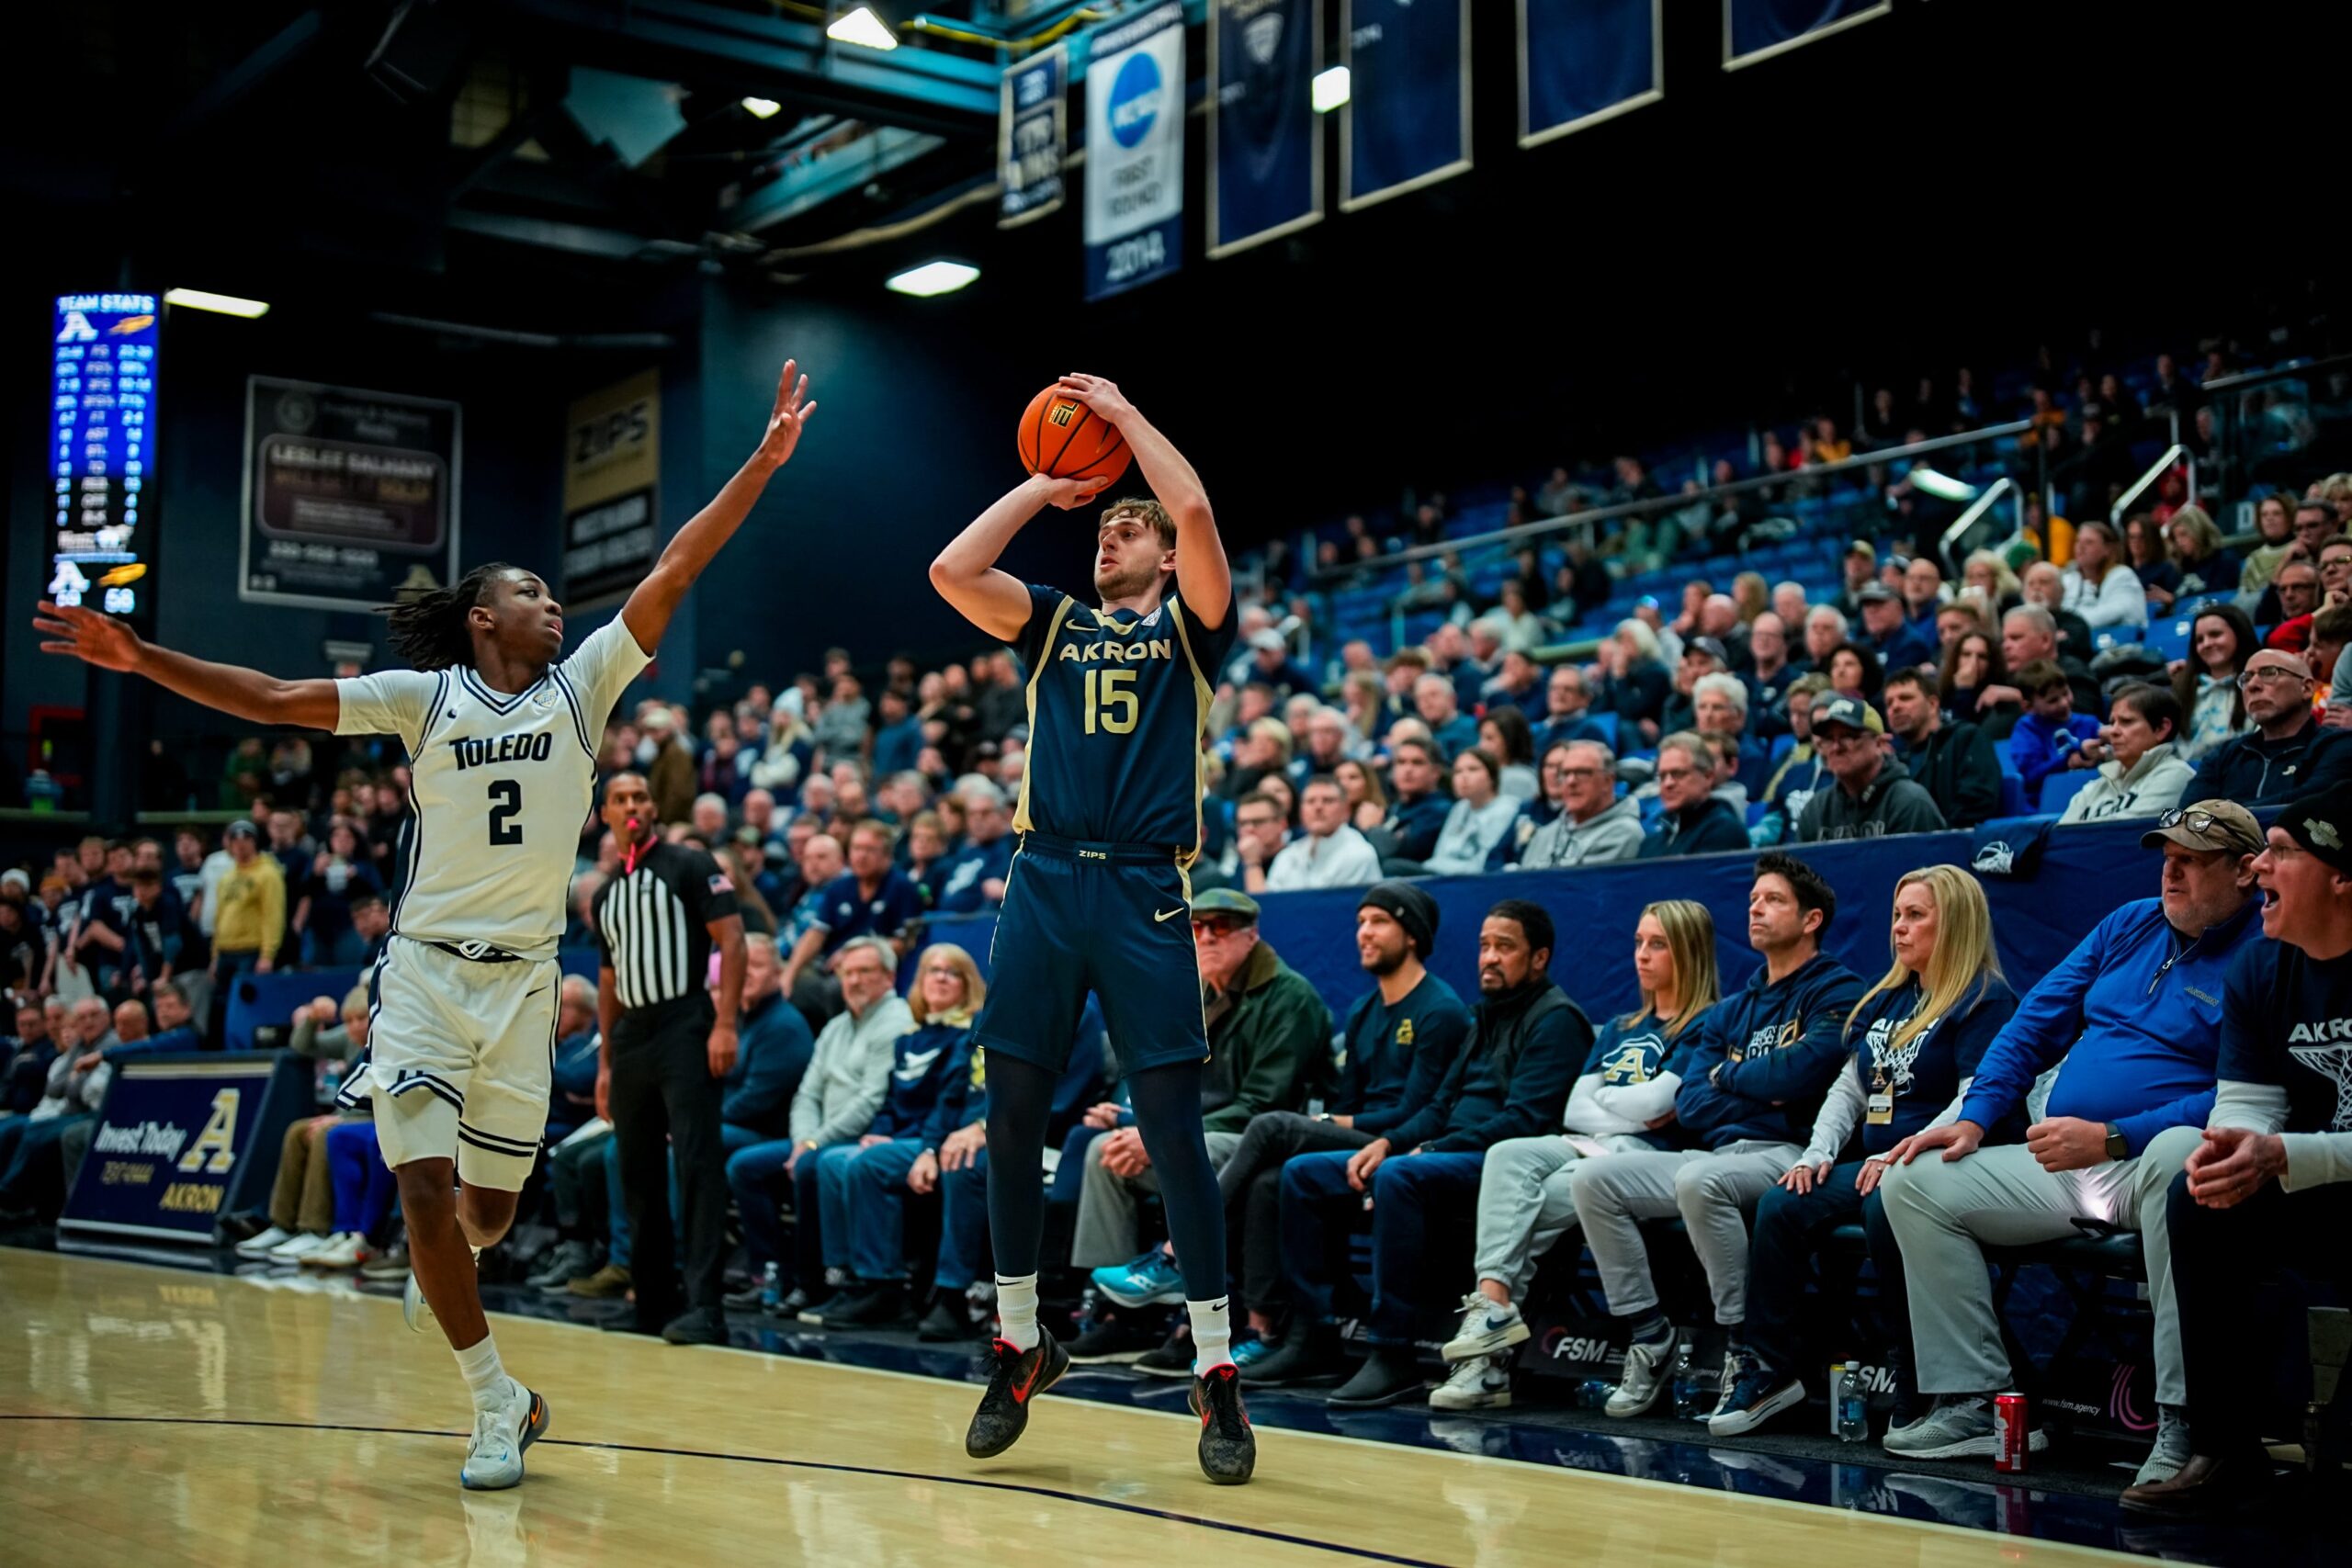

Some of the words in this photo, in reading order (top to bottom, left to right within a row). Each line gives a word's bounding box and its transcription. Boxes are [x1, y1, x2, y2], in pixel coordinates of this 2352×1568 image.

[57, 295, 99, 313] TEAM
[100, 294, 154, 313] STATS
[1058, 638, 1171, 663] AKRON
[1085, 669, 1138, 735] 15
[448, 731, 553, 771] TOLEDO
[488, 779, 523, 846] 2
[1079, 850, 1106, 860] ZIPS
[94, 1121, 146, 1154] Invest
[140, 1121, 187, 1163] Today
[177, 1088, 240, 1173] A
[159, 1182, 225, 1213] AKRON
[1553, 1337, 1609, 1362] FSM
[2041, 1398, 2101, 1416] www.fsm.agency
